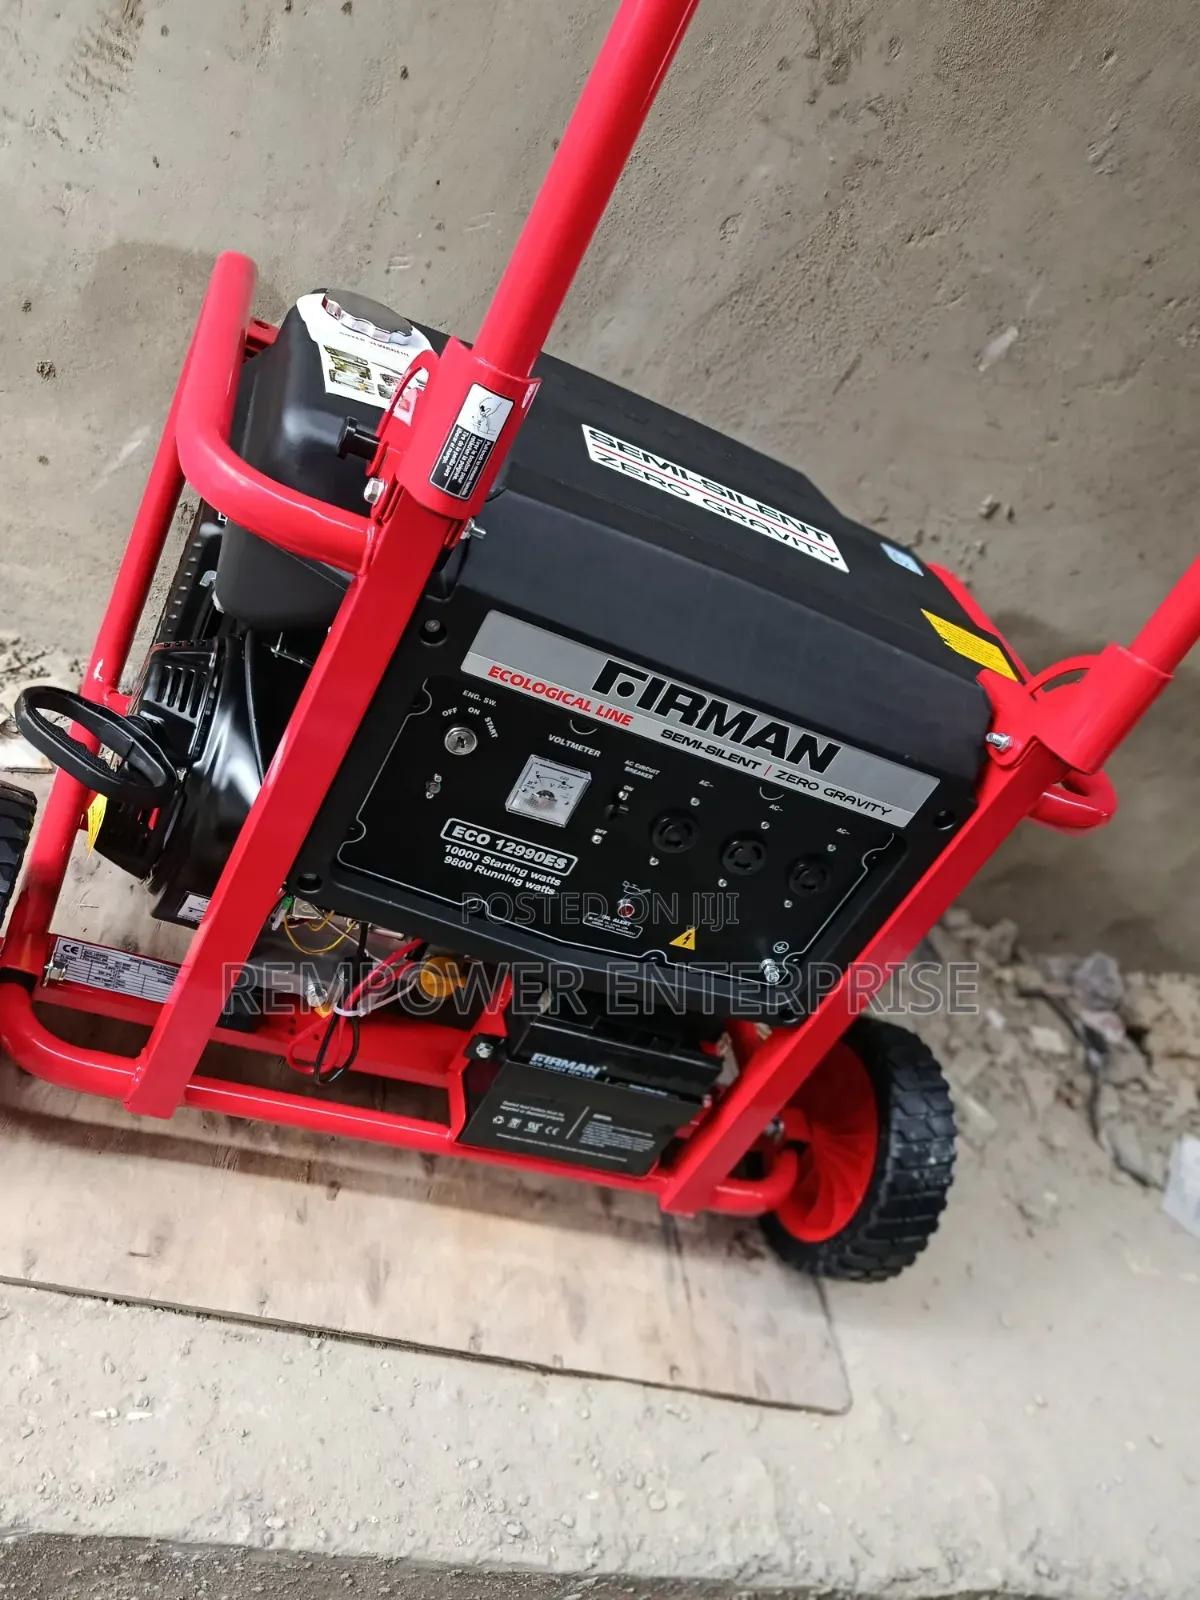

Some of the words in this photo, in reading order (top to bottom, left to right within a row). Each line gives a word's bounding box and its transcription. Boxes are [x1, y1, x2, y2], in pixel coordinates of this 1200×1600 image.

[588, 429, 830, 542] SEMI-SILENT
[596, 453, 690, 498] ZERO
[702, 498, 840, 564] GRAVITY
[462, 689, 481, 701] ENG.
[483, 697, 497, 707] SW.
[487, 664, 591, 712] ECOLOGICAL
[595, 704, 633, 727] LINE
[442, 707, 458, 717] OFF
[467, 706, 481, 716] ON
[591, 658, 842, 776] FIRMAN
[484, 717, 498, 739] START
[548, 734, 601, 758] VOLTMETER
[624, 766, 654, 779] BREAKER
[635, 763, 660, 775] CIRCUIT
[660, 728, 762, 771] SEMI-SILENT
[774, 770, 820, 791] ZERO
[823, 787, 892, 815] GRAVITY
[451, 825, 491, 846] ECO
[495, 839, 568, 870] 12990ES
[444, 844, 480, 861] 10000
[481, 855, 529, 878] Starting
[530, 872, 562, 886] watts
[444, 855, 473, 871] 9800
[474, 864, 524, 888] Running
[525, 881, 556, 895] watts
[612, 918, 631, 926] ALERT
[530, 1052, 600, 1075] FIRMAN
[544, 1064, 566, 1073] POWER
